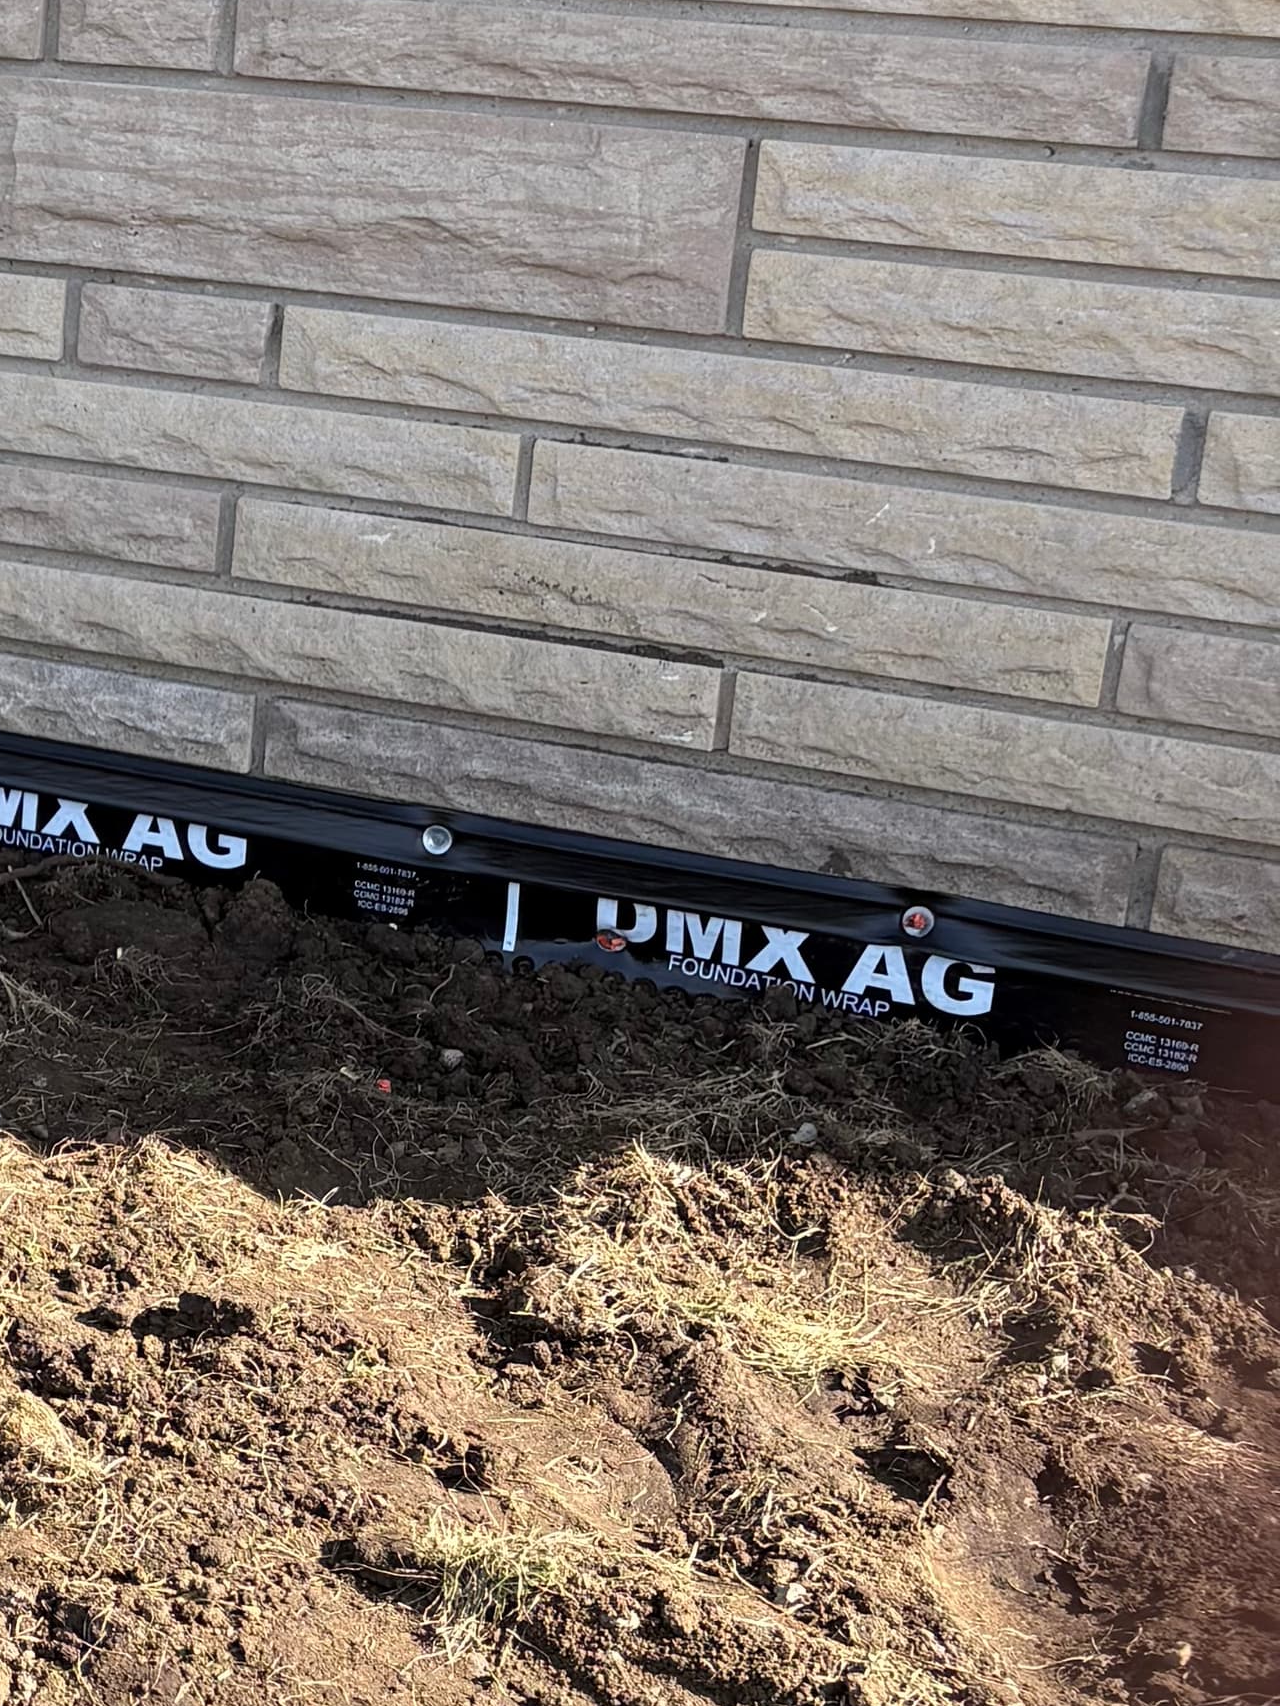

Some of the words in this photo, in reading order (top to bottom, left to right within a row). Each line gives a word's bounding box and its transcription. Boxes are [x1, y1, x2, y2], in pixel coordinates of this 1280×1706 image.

[122, 813, 247, 869] AG
[597, 897, 815, 984] DMX
[841, 944, 996, 1016] AG
[820, 987, 890, 1018] WRAP
[1124, 1041, 1155, 1054] CCMC
[1125, 1031, 1157, 1045] CCMC
